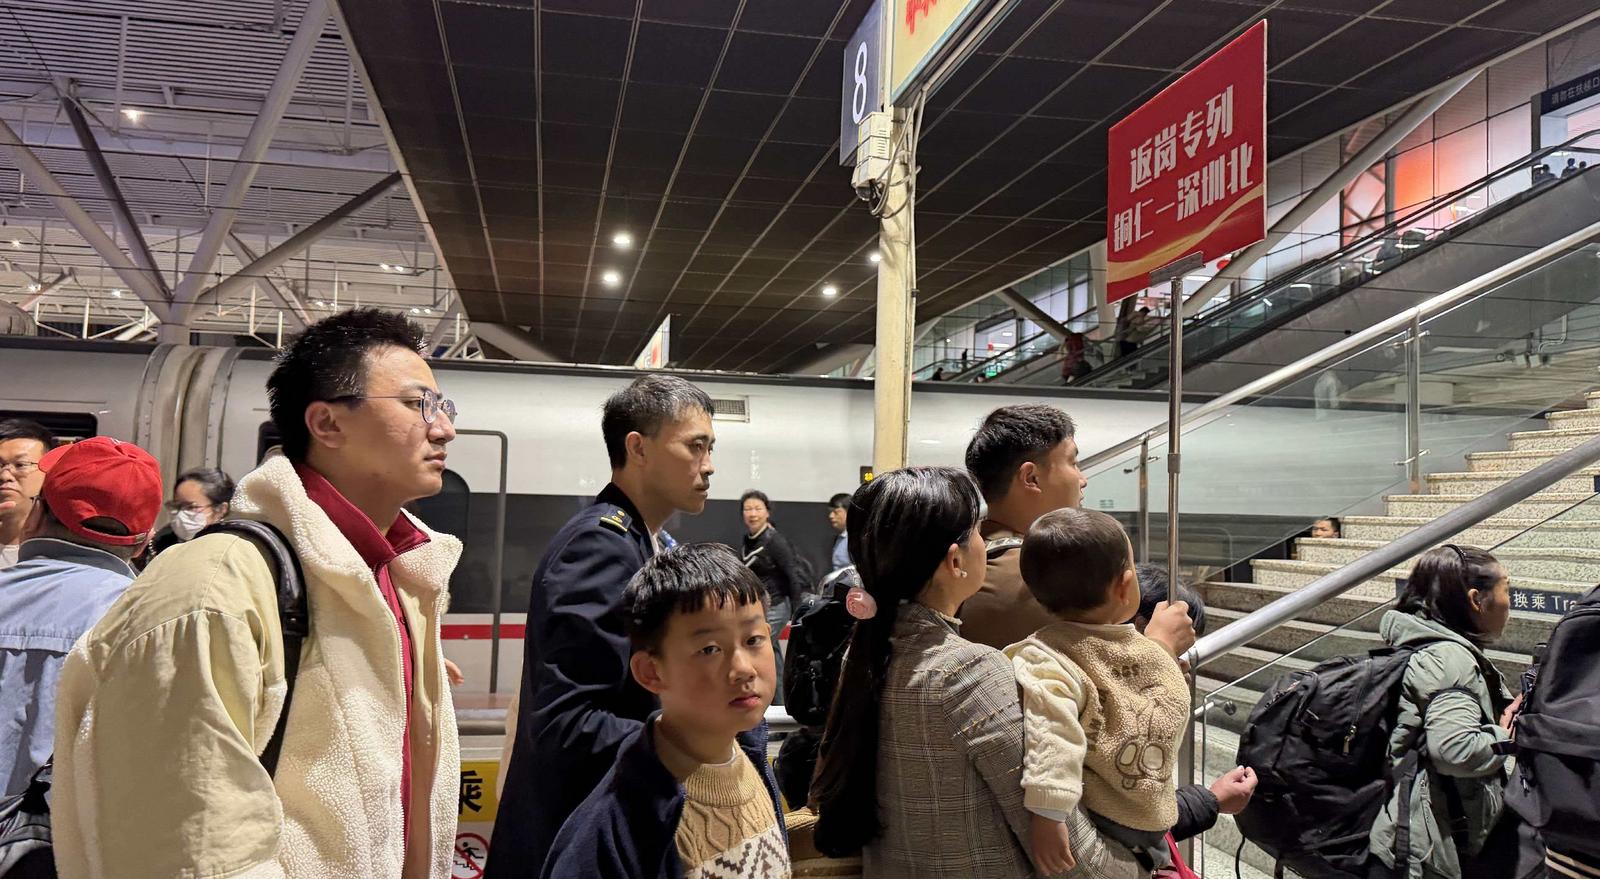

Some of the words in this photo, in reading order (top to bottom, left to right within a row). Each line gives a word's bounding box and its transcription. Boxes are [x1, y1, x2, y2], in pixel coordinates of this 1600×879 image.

[852, 41, 868, 125] 8
[1130, 84, 1234, 193] 返岗专列
[1513, 590, 1546, 610] 换乘
